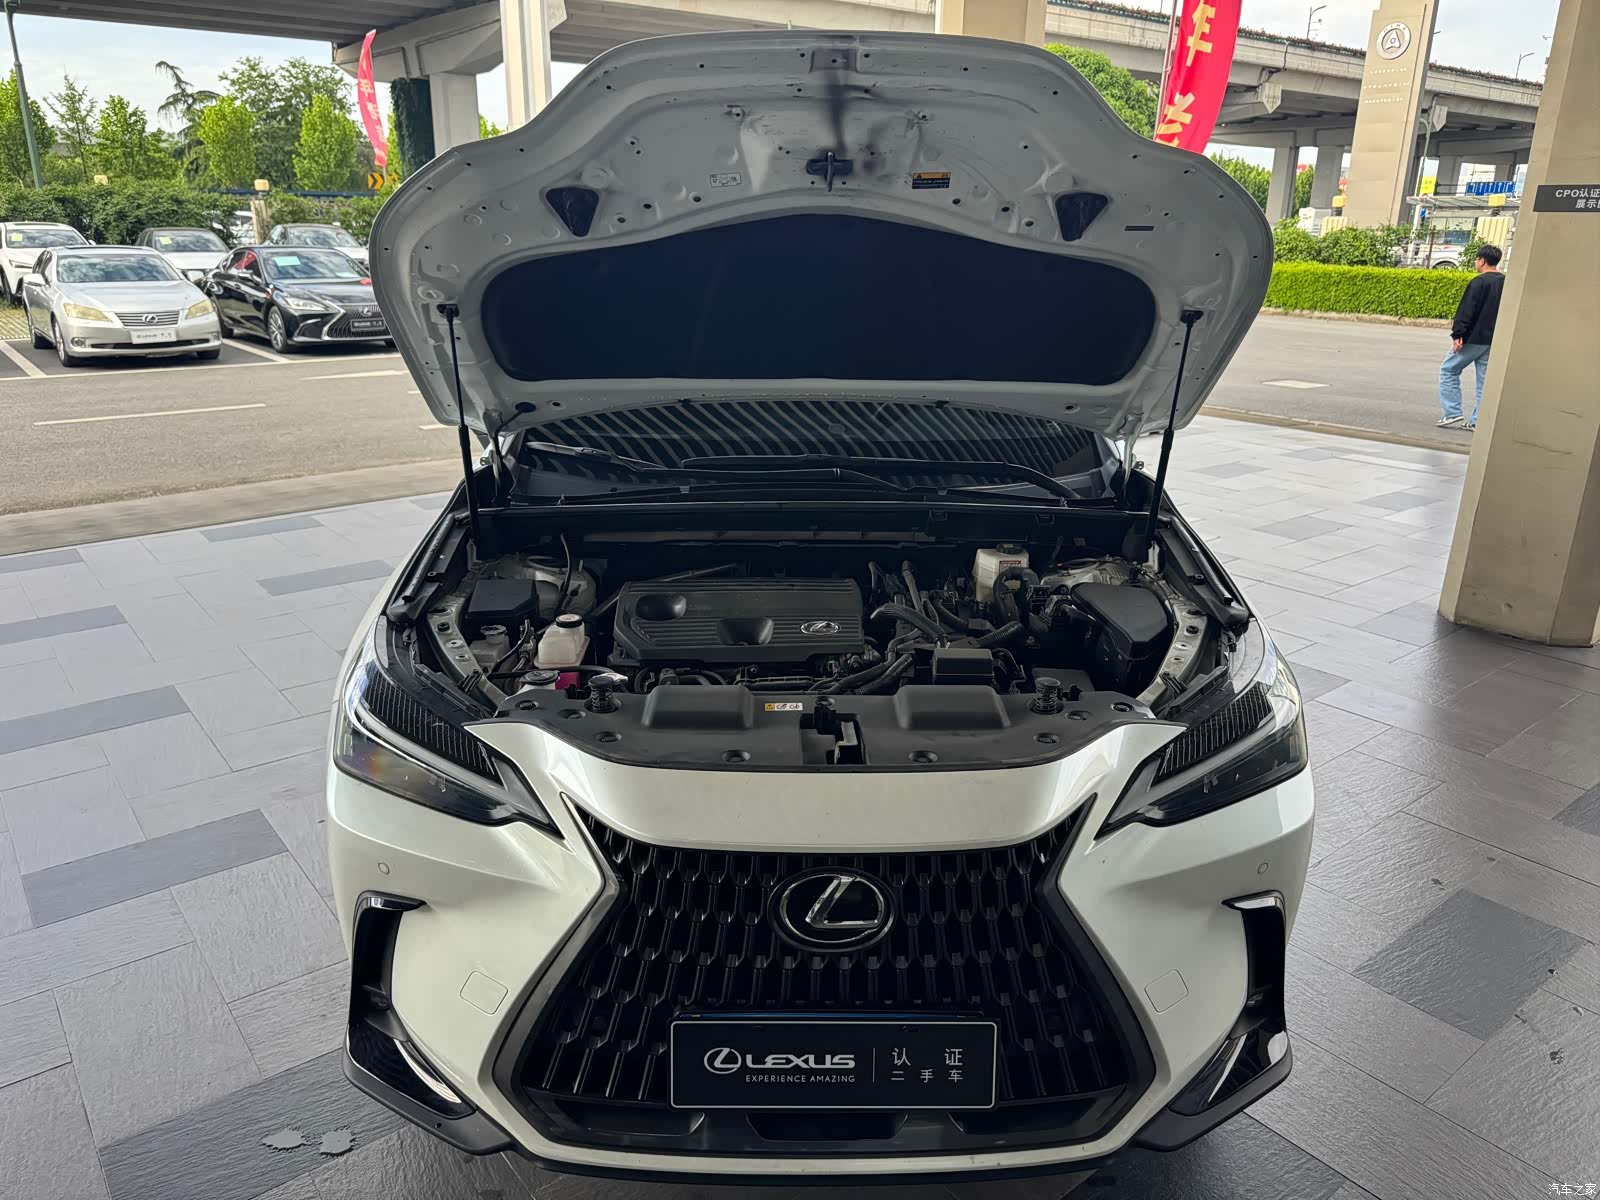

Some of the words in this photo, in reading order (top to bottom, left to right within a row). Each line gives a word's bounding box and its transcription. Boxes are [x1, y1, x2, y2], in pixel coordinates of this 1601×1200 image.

[1575, 199, 1600, 209] 展示
[745, 1054, 856, 1069] LEXUS
[891, 1047, 963, 1066] 认证
[745, 1074, 807, 1083] EXPERIENCE
[809, 1074, 856, 1083] AMAZING
[890, 1068, 964, 1083] 二手车
